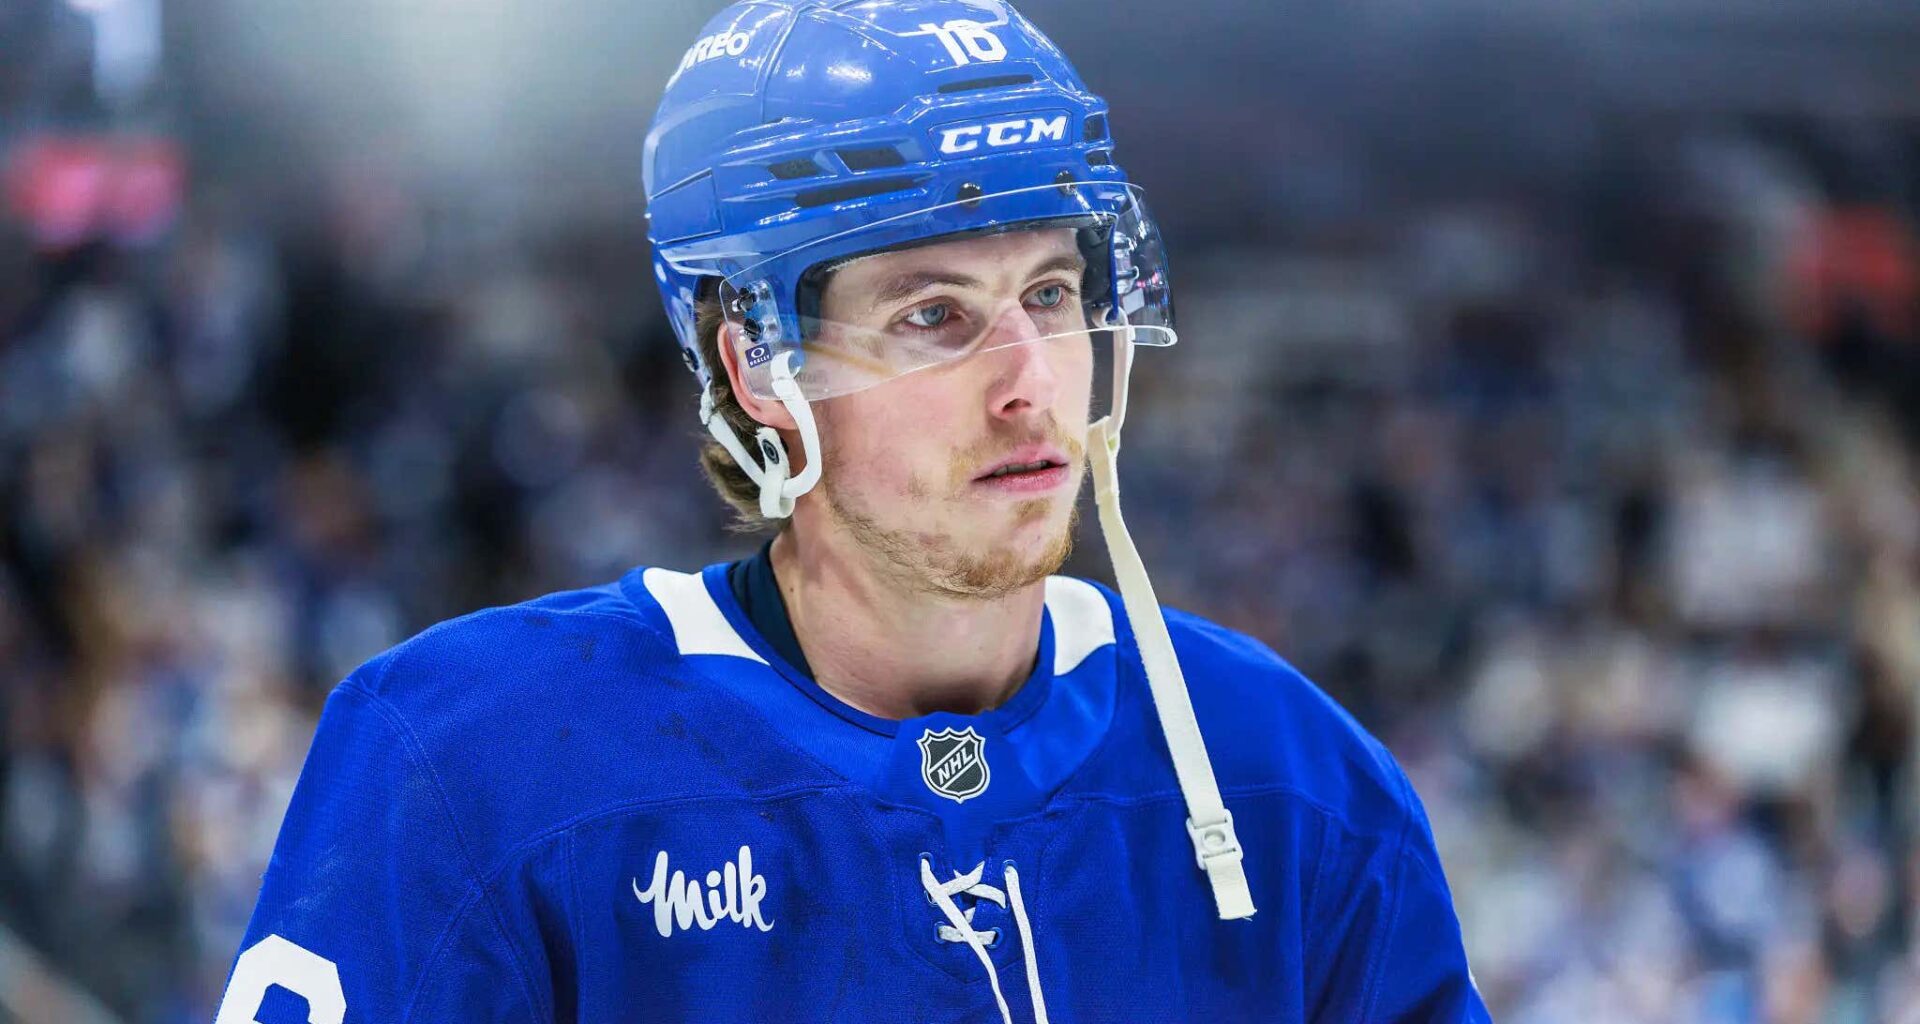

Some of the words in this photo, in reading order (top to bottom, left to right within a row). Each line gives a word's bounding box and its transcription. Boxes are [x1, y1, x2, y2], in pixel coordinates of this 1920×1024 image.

[919, 20, 1008, 67] 16
[940, 116, 1068, 154] CCM
[937, 747, 973, 785] NHL
[632, 845, 775, 938] Milk
